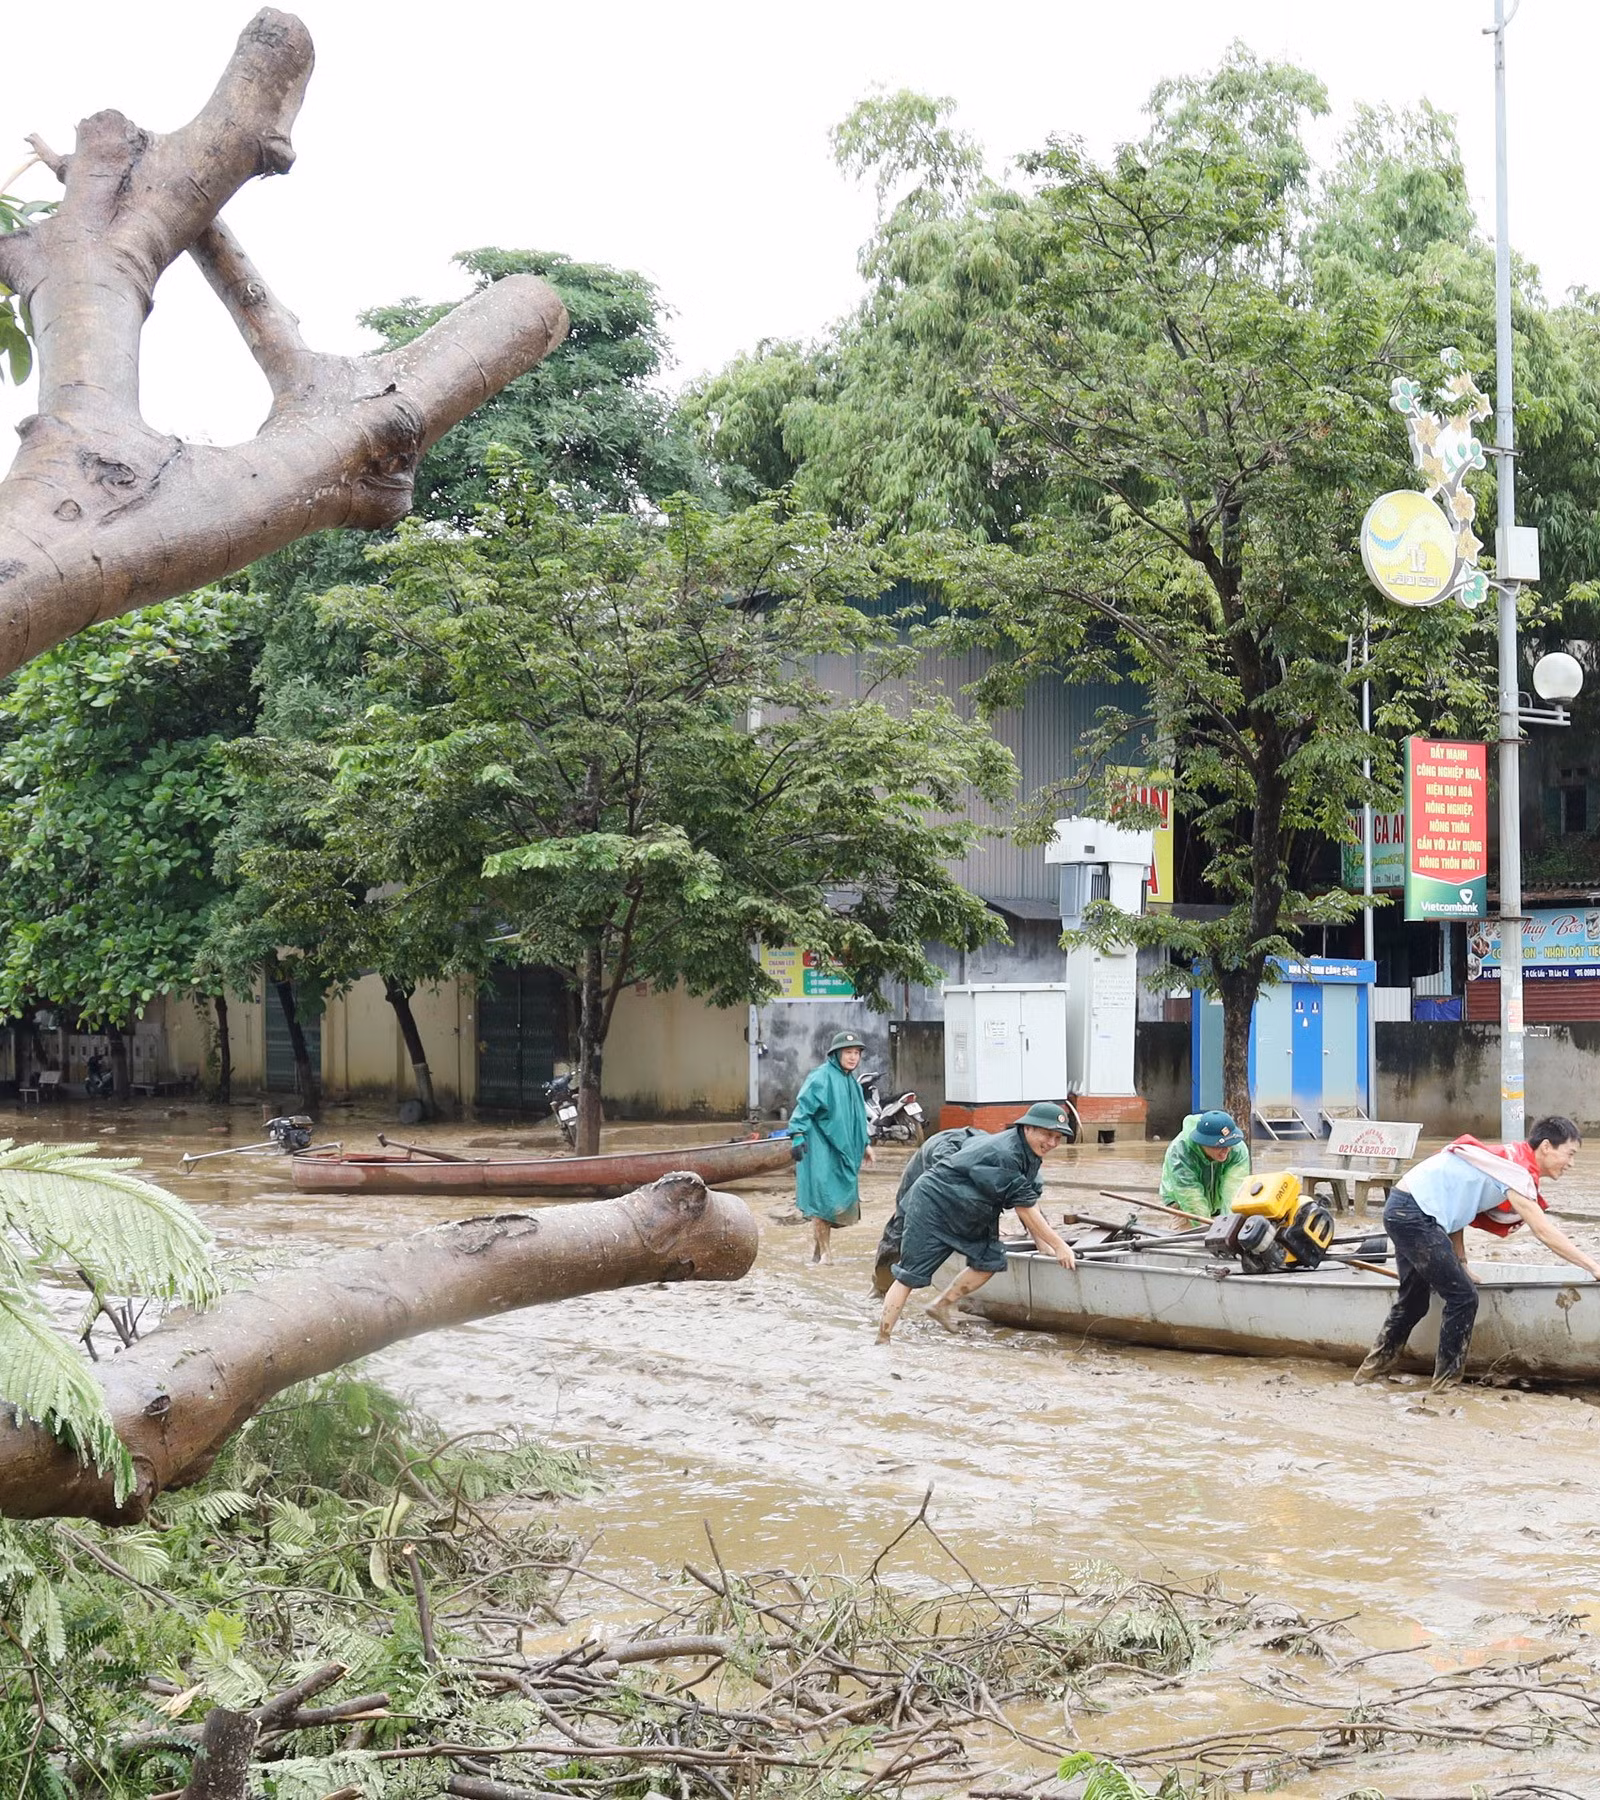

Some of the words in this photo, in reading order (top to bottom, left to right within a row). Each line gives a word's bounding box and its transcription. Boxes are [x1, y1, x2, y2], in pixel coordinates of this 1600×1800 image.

[1374, 815, 1389, 844] CA
[1420, 900, 1478, 913] Vietcombank
[1551, 913, 1585, 936] Béo
[1544, 944, 1567, 961] NHẬN
